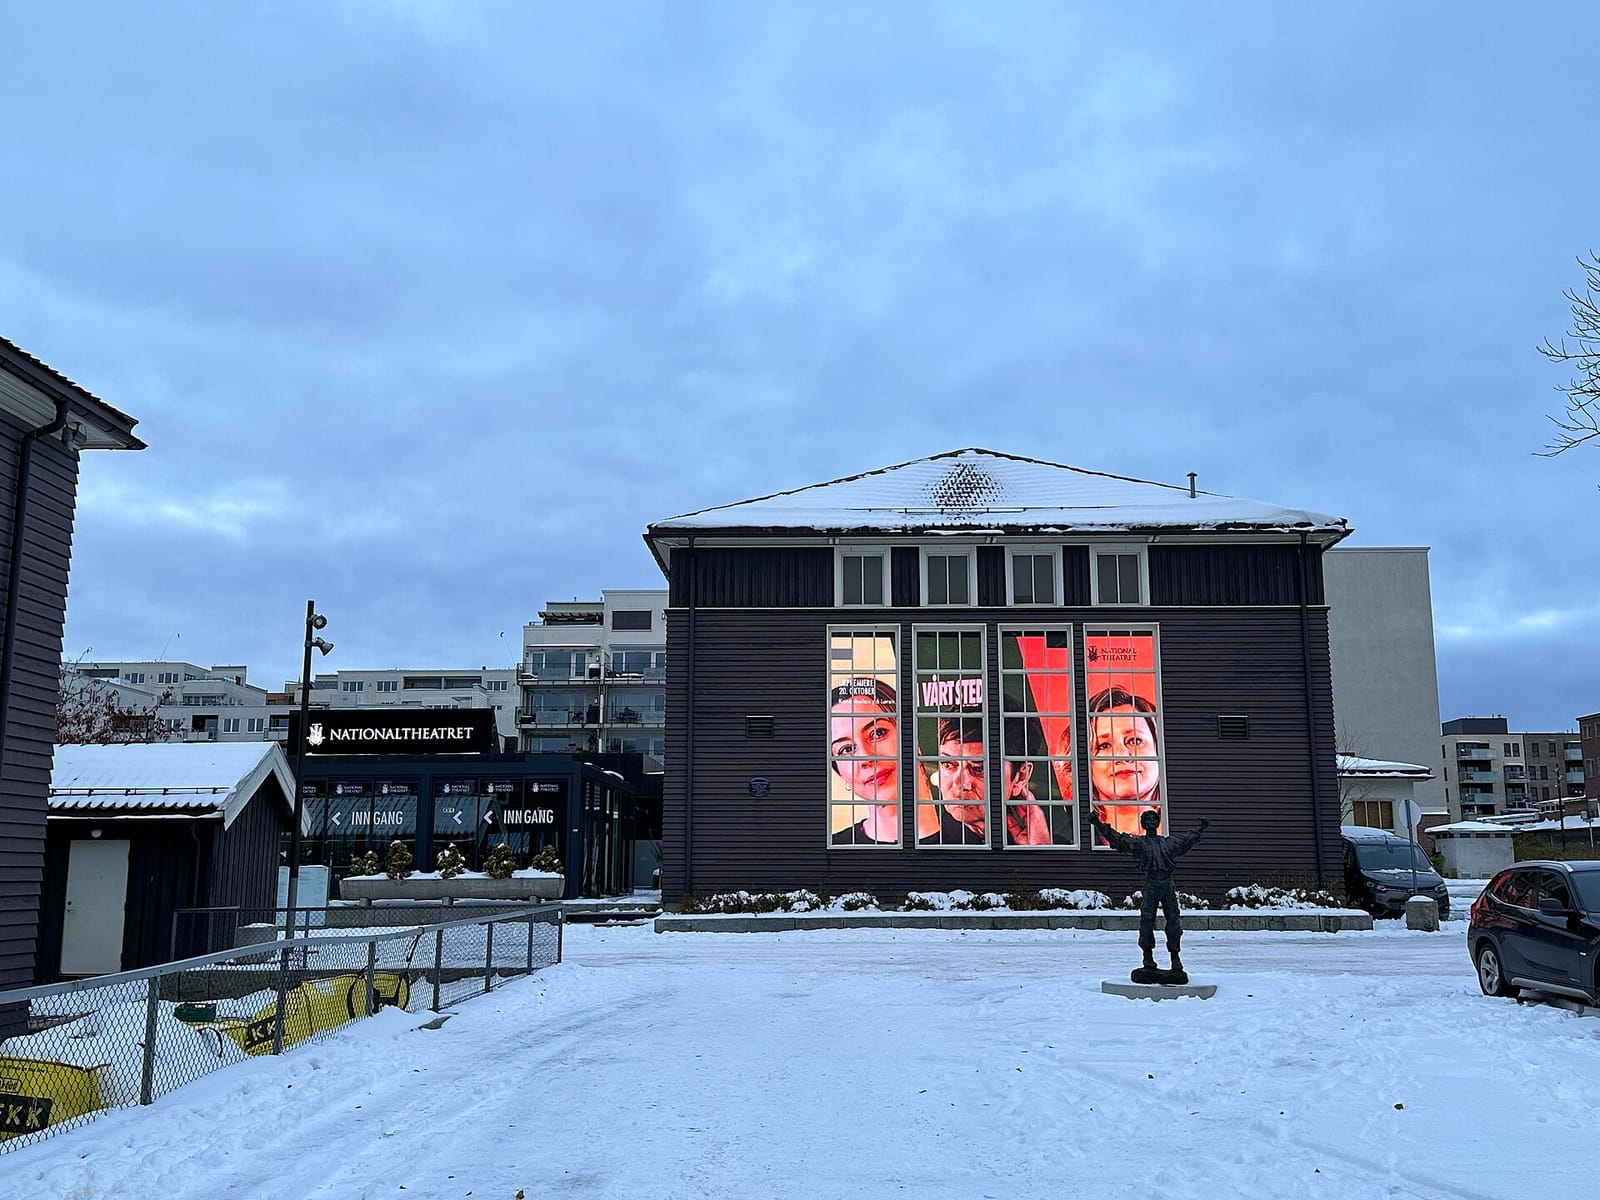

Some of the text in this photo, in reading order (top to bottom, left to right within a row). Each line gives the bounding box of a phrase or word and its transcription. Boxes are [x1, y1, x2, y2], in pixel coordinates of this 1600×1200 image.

[838, 687, 849, 695] 20.
[922, 674, 955, 707] VÅRT
[955, 679, 983, 705] STED
[329, 727, 474, 741] NATIONALTHEATRET
